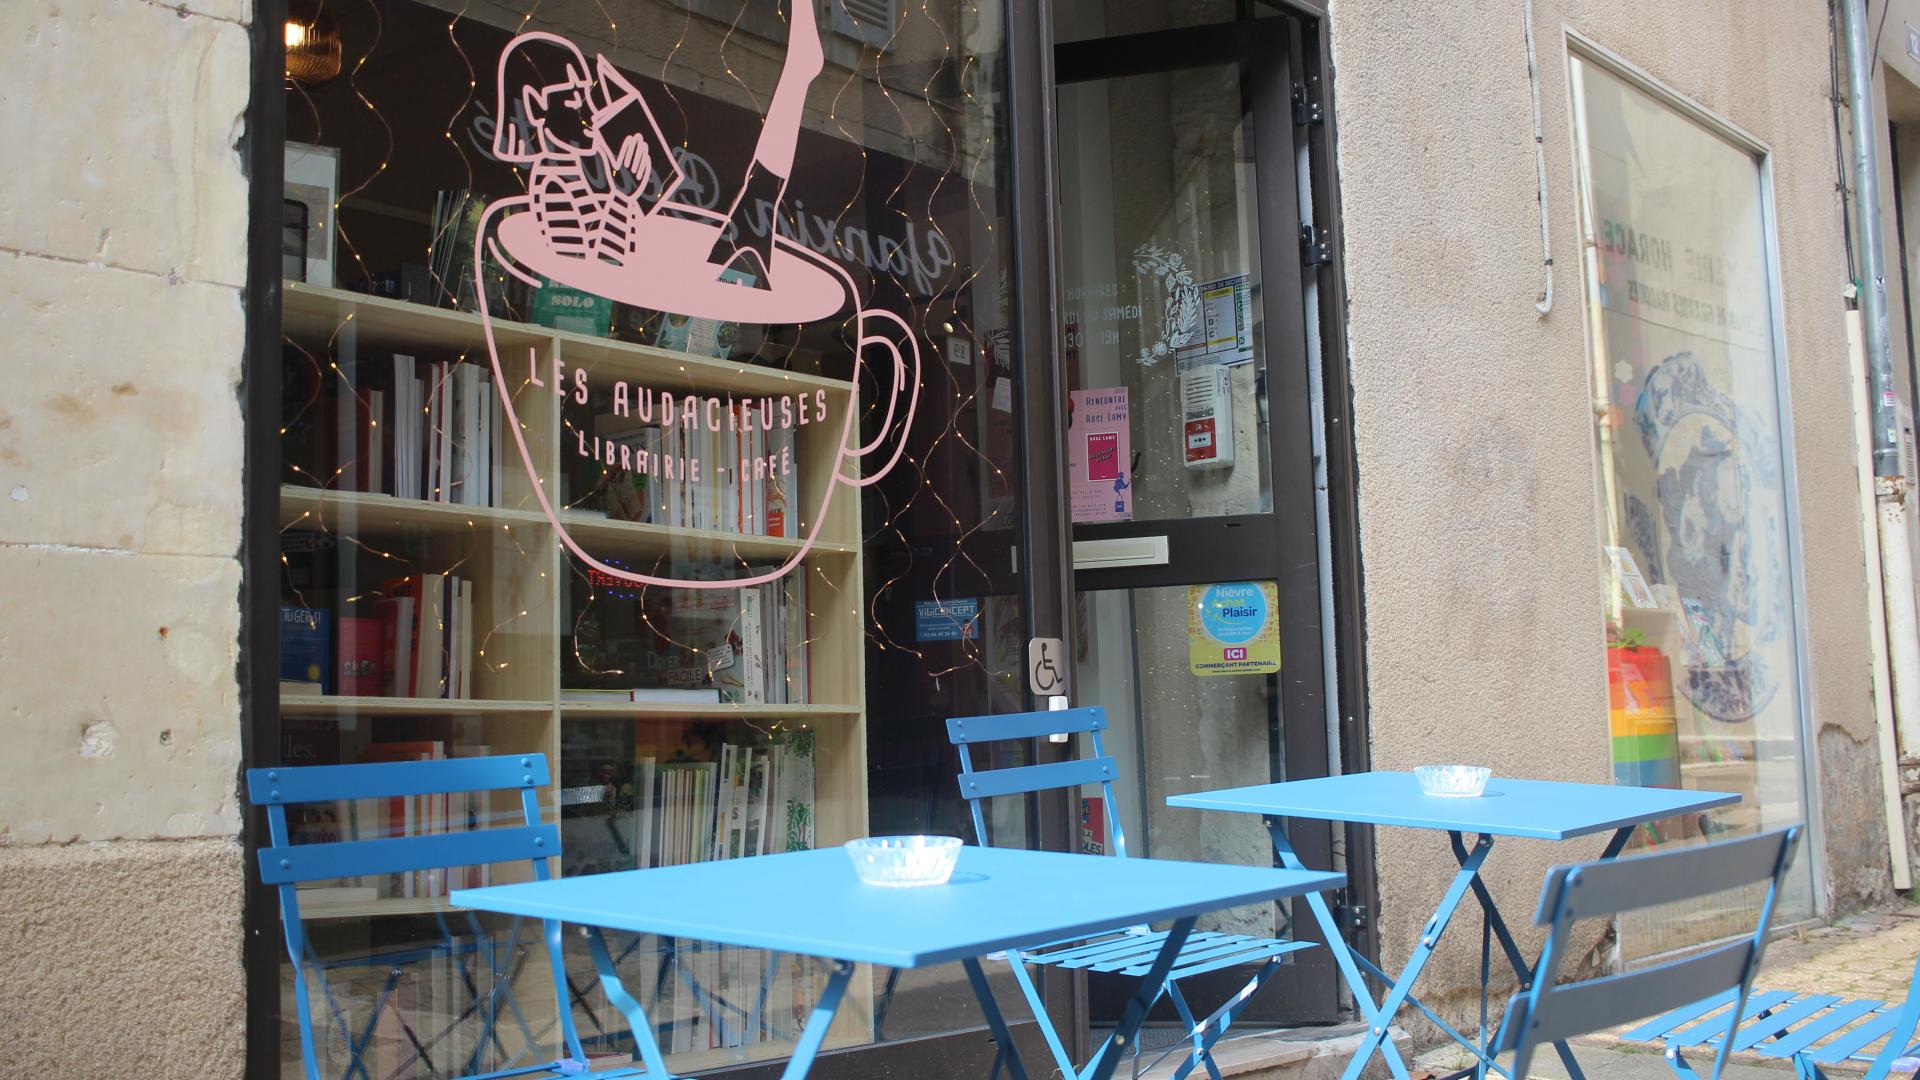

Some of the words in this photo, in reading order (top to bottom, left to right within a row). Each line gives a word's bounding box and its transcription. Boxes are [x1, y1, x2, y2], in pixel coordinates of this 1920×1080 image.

[551, 295, 595, 308] SOLO
[1103, 305, 1142, 321] SAMEDI
[529, 346, 589, 405] LES
[613, 380, 828, 433] AUDACIEUSES
[577, 429, 701, 482] LIBRAIRIE
[741, 445, 791, 483] CAFÉ
[1216, 585, 1254, 598] Nièvre
[1212, 597, 1245, 608] Achat
[1222, 606, 1258, 618] Plaisir
[1226, 648, 1244, 660] ICI
[1195, 661, 1238, 670] COMMERÇANT
[667, 668, 702, 682] FACILE
